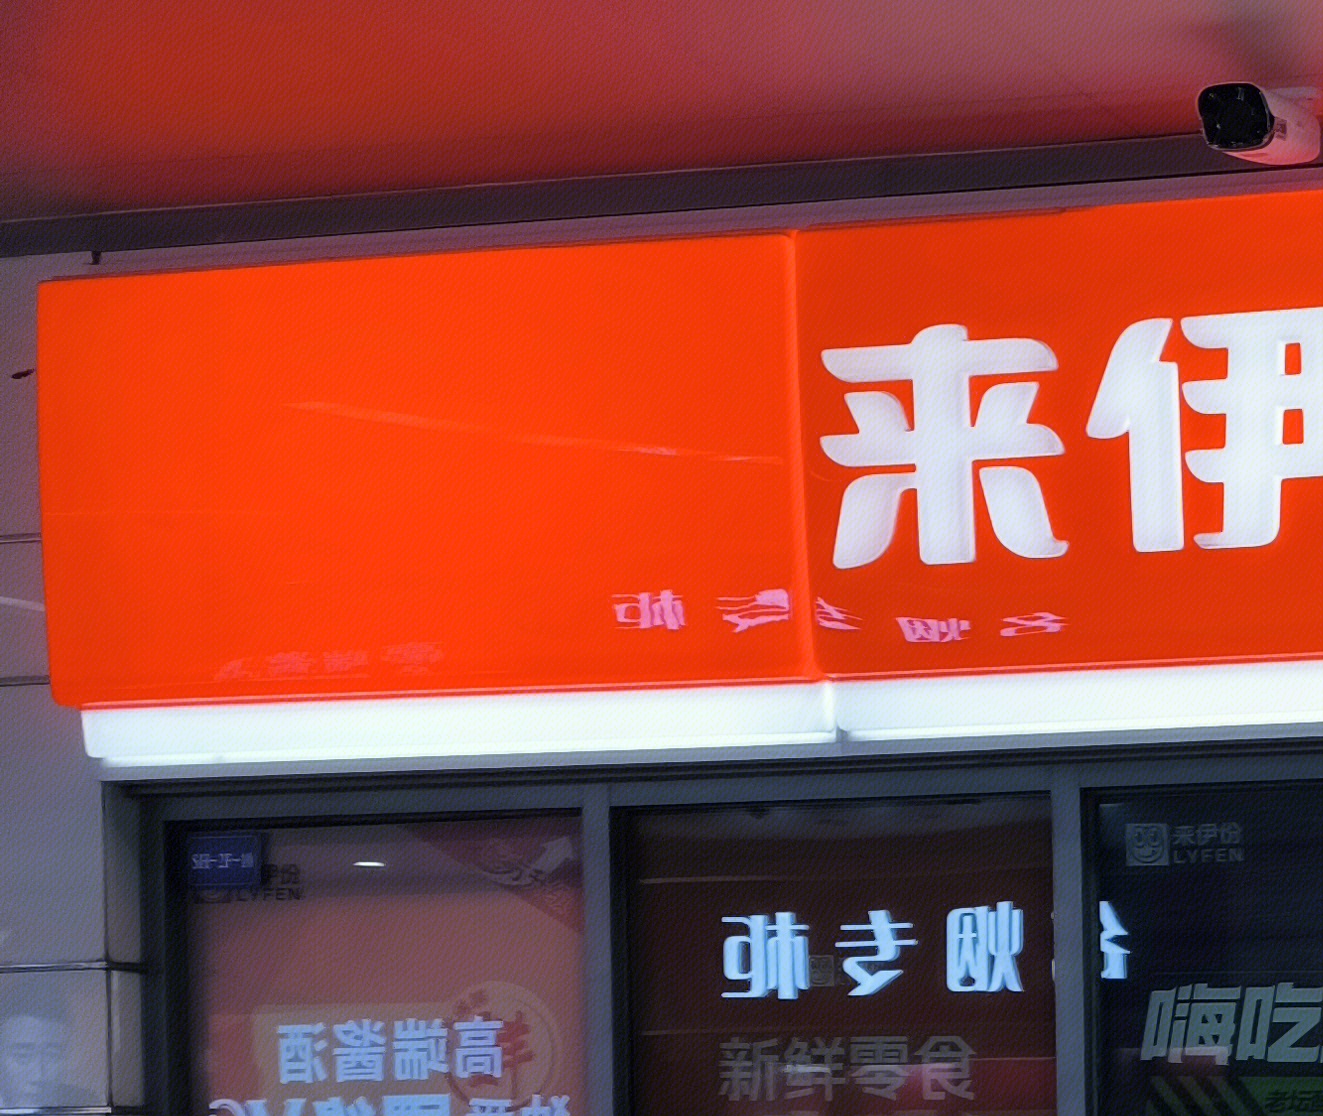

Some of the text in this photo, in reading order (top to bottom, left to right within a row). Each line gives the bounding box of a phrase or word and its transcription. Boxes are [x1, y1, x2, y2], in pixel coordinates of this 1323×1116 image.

[1172, 822, 1245, 846] 来伊份
[1173, 847, 1246, 864] LYFEN
[718, 1034, 977, 1103] 新鲜零食
